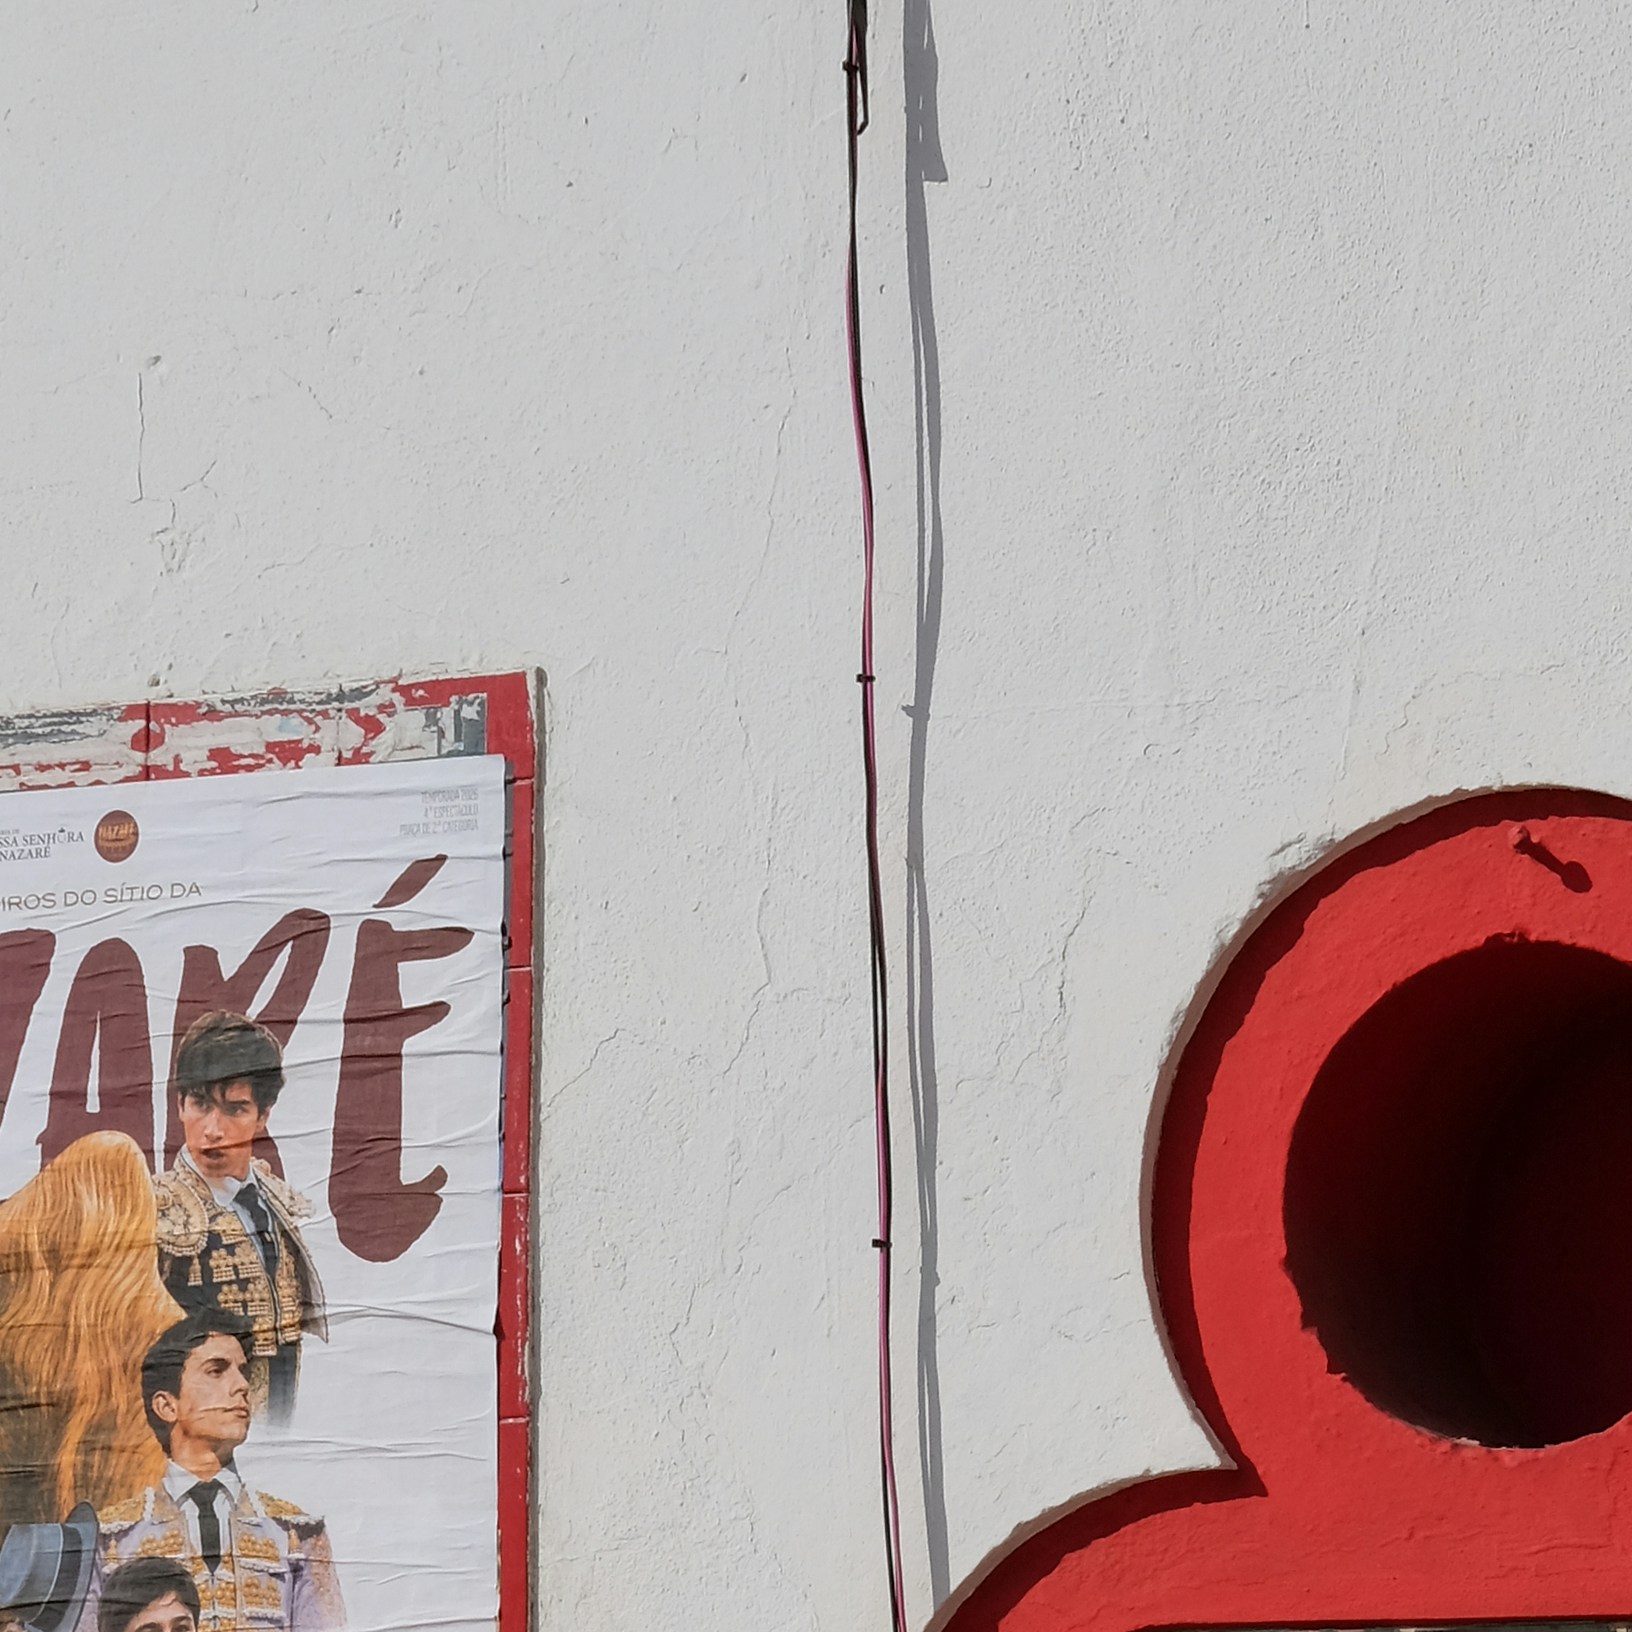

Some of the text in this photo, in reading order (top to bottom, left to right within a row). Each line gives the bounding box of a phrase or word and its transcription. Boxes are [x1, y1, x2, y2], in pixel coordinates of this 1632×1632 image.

[64, 881, 202, 907] DO SÍTIO DA
